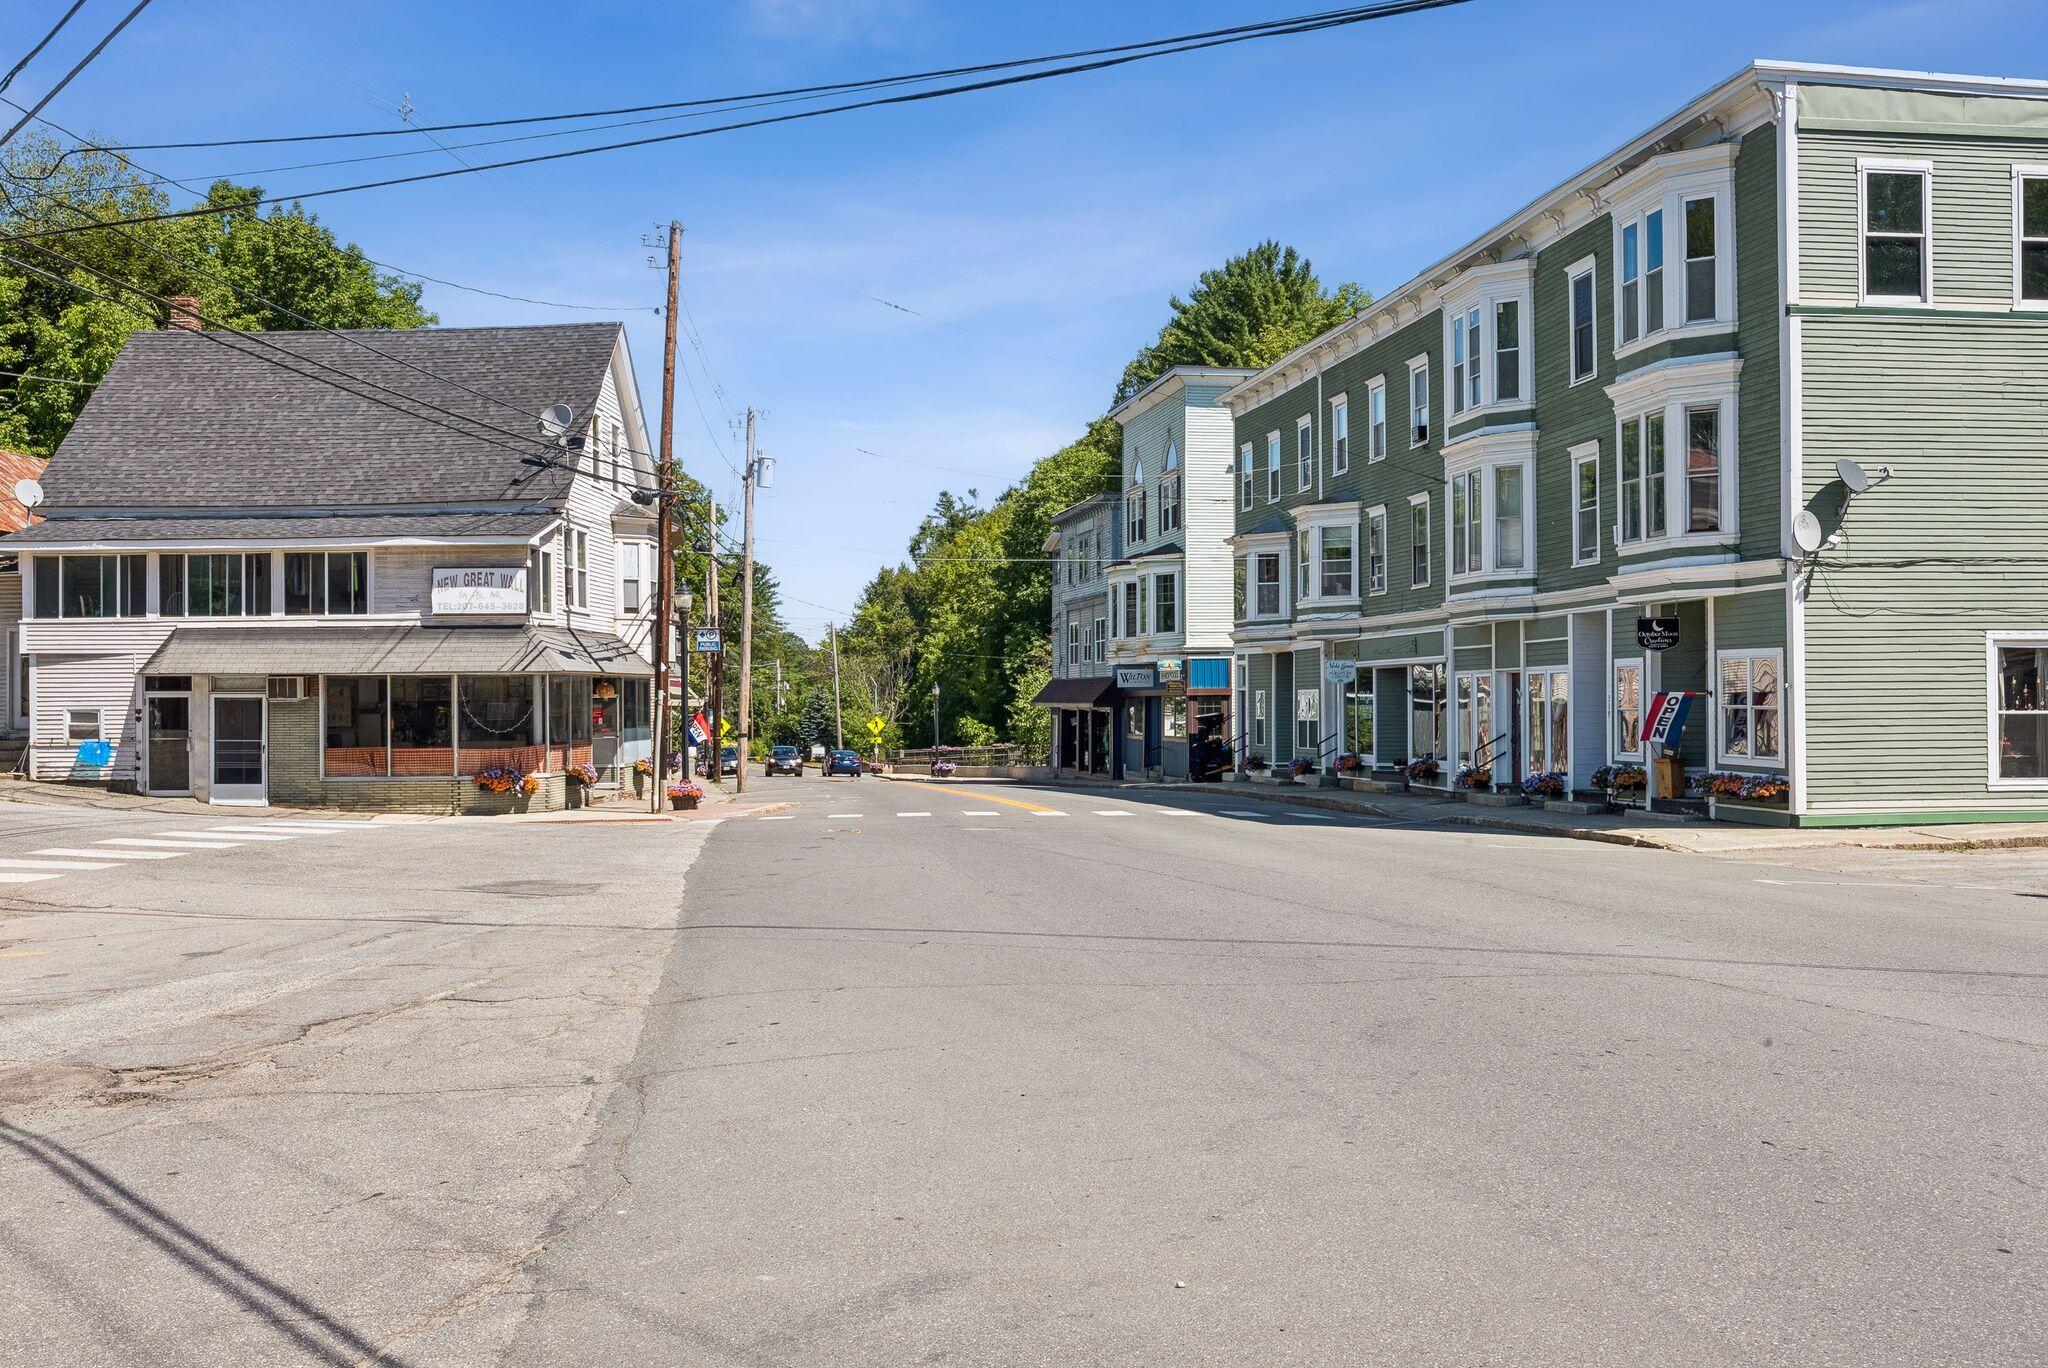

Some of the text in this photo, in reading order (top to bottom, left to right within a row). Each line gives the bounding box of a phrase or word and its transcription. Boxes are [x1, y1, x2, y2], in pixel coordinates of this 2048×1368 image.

[437, 571, 525, 593] NEW GREAT WALL
[1638, 630, 1661, 638] October
[1652, 696, 1680, 739] OPEN
[688, 720, 703, 739] OPEN
